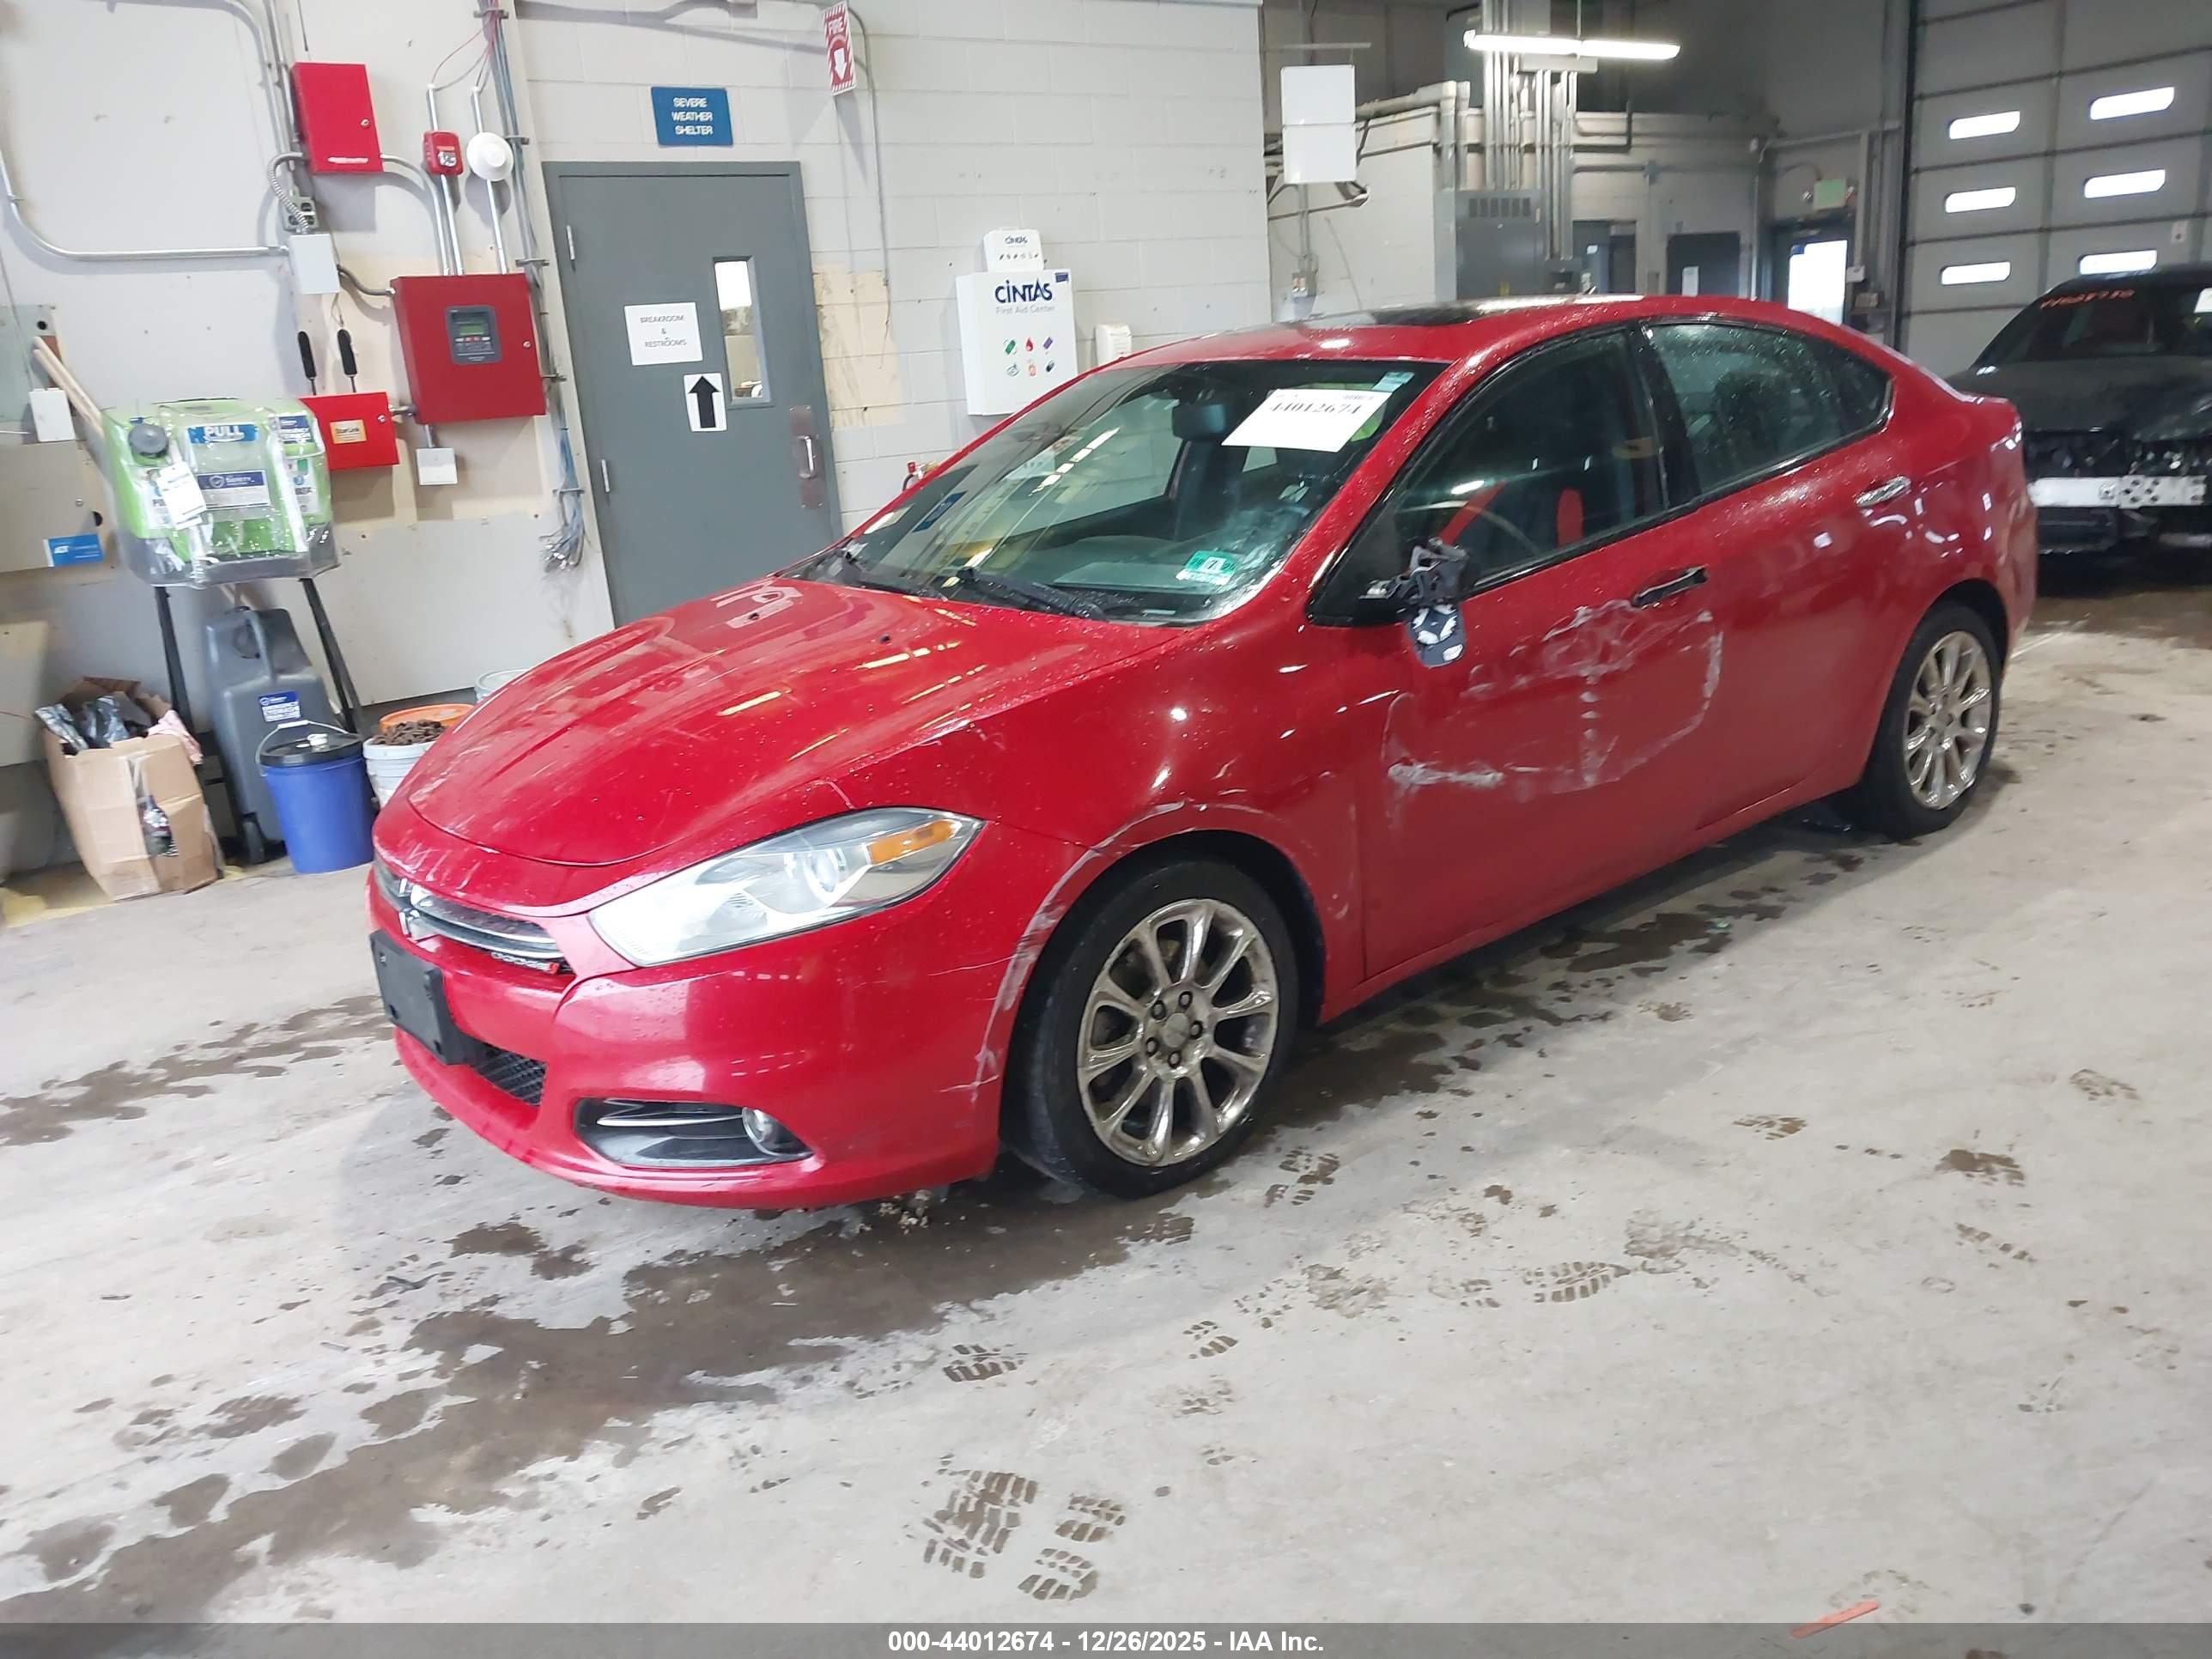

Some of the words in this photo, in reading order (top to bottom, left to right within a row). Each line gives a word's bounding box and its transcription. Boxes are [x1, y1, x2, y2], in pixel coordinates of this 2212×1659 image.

[829, 16, 845, 35] FIRE
[672, 97, 708, 108] SEVERE
[672, 112, 714, 122] WEATHER
[675, 125, 714, 136] SHELTER
[640, 315, 684, 324] BREAKROOM
[644, 339, 687, 348] RESTROOMS
[204, 426, 245, 437] PULL
